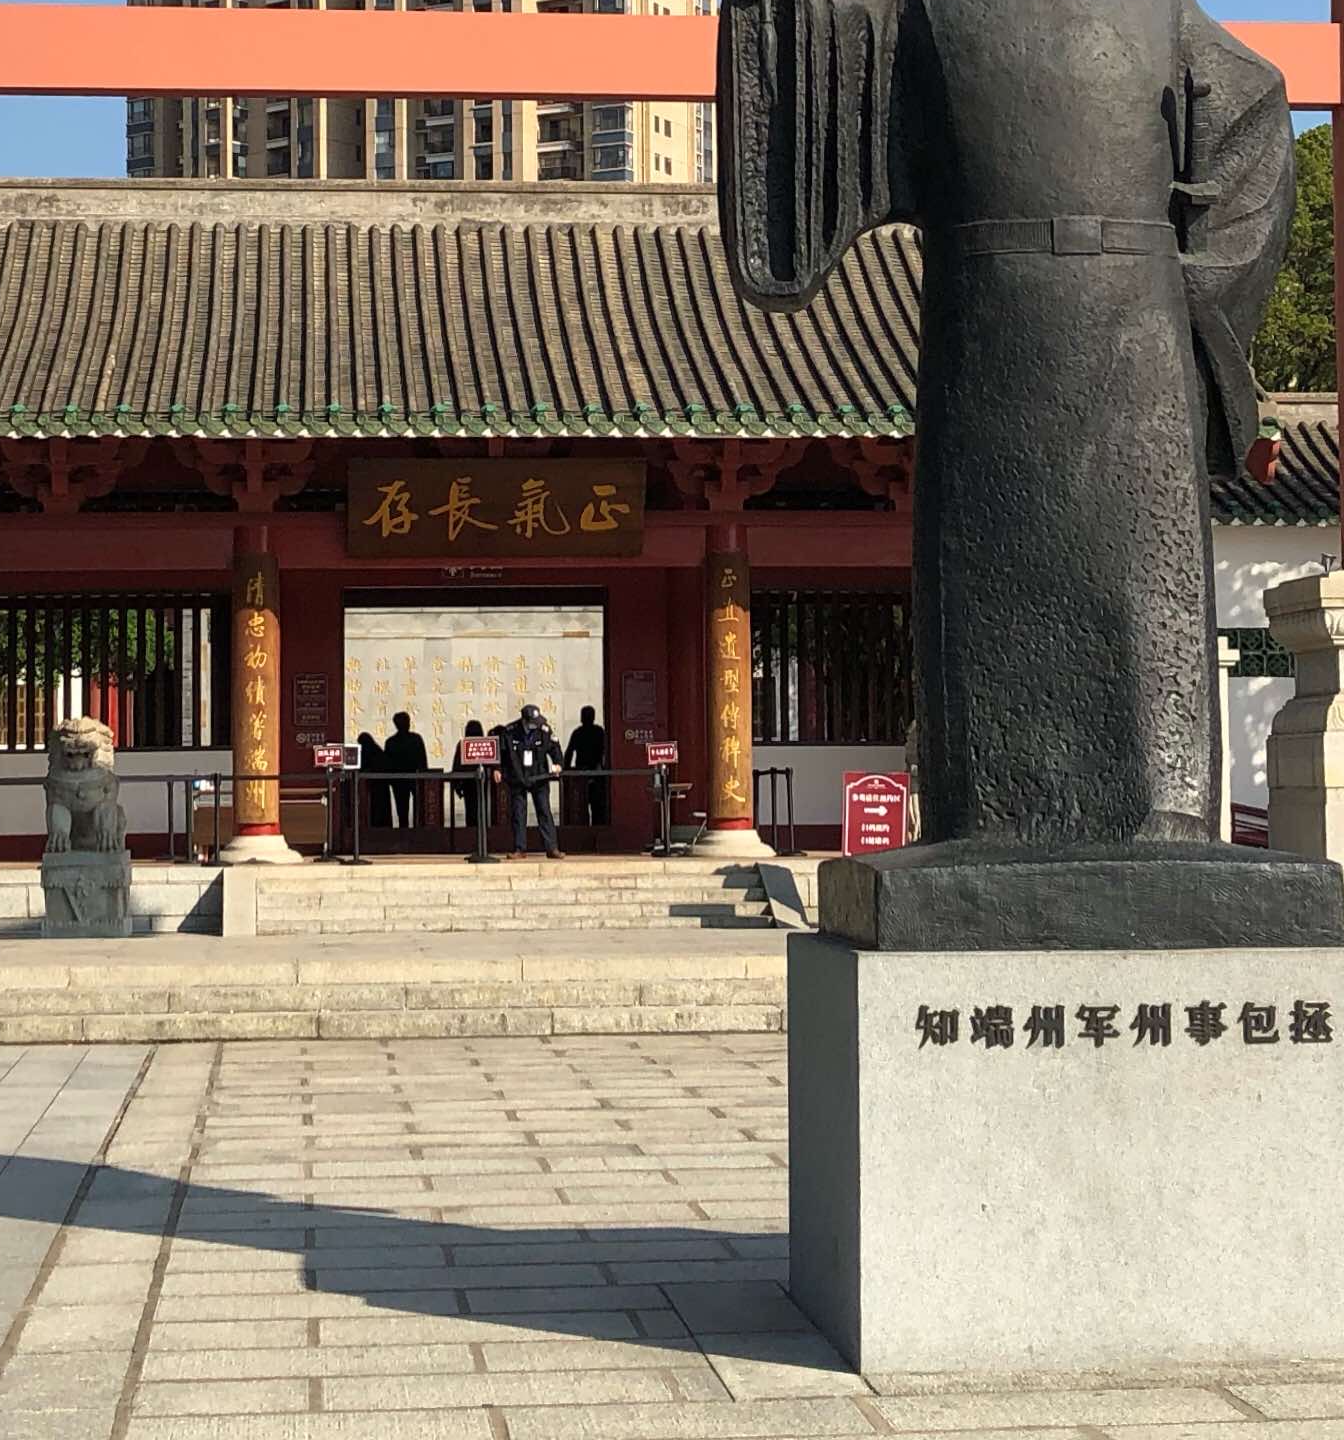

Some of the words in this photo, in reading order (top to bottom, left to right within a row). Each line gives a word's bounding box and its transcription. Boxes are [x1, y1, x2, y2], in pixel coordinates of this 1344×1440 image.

[914, 999, 1336, 1050] 知端州军州事包拯
